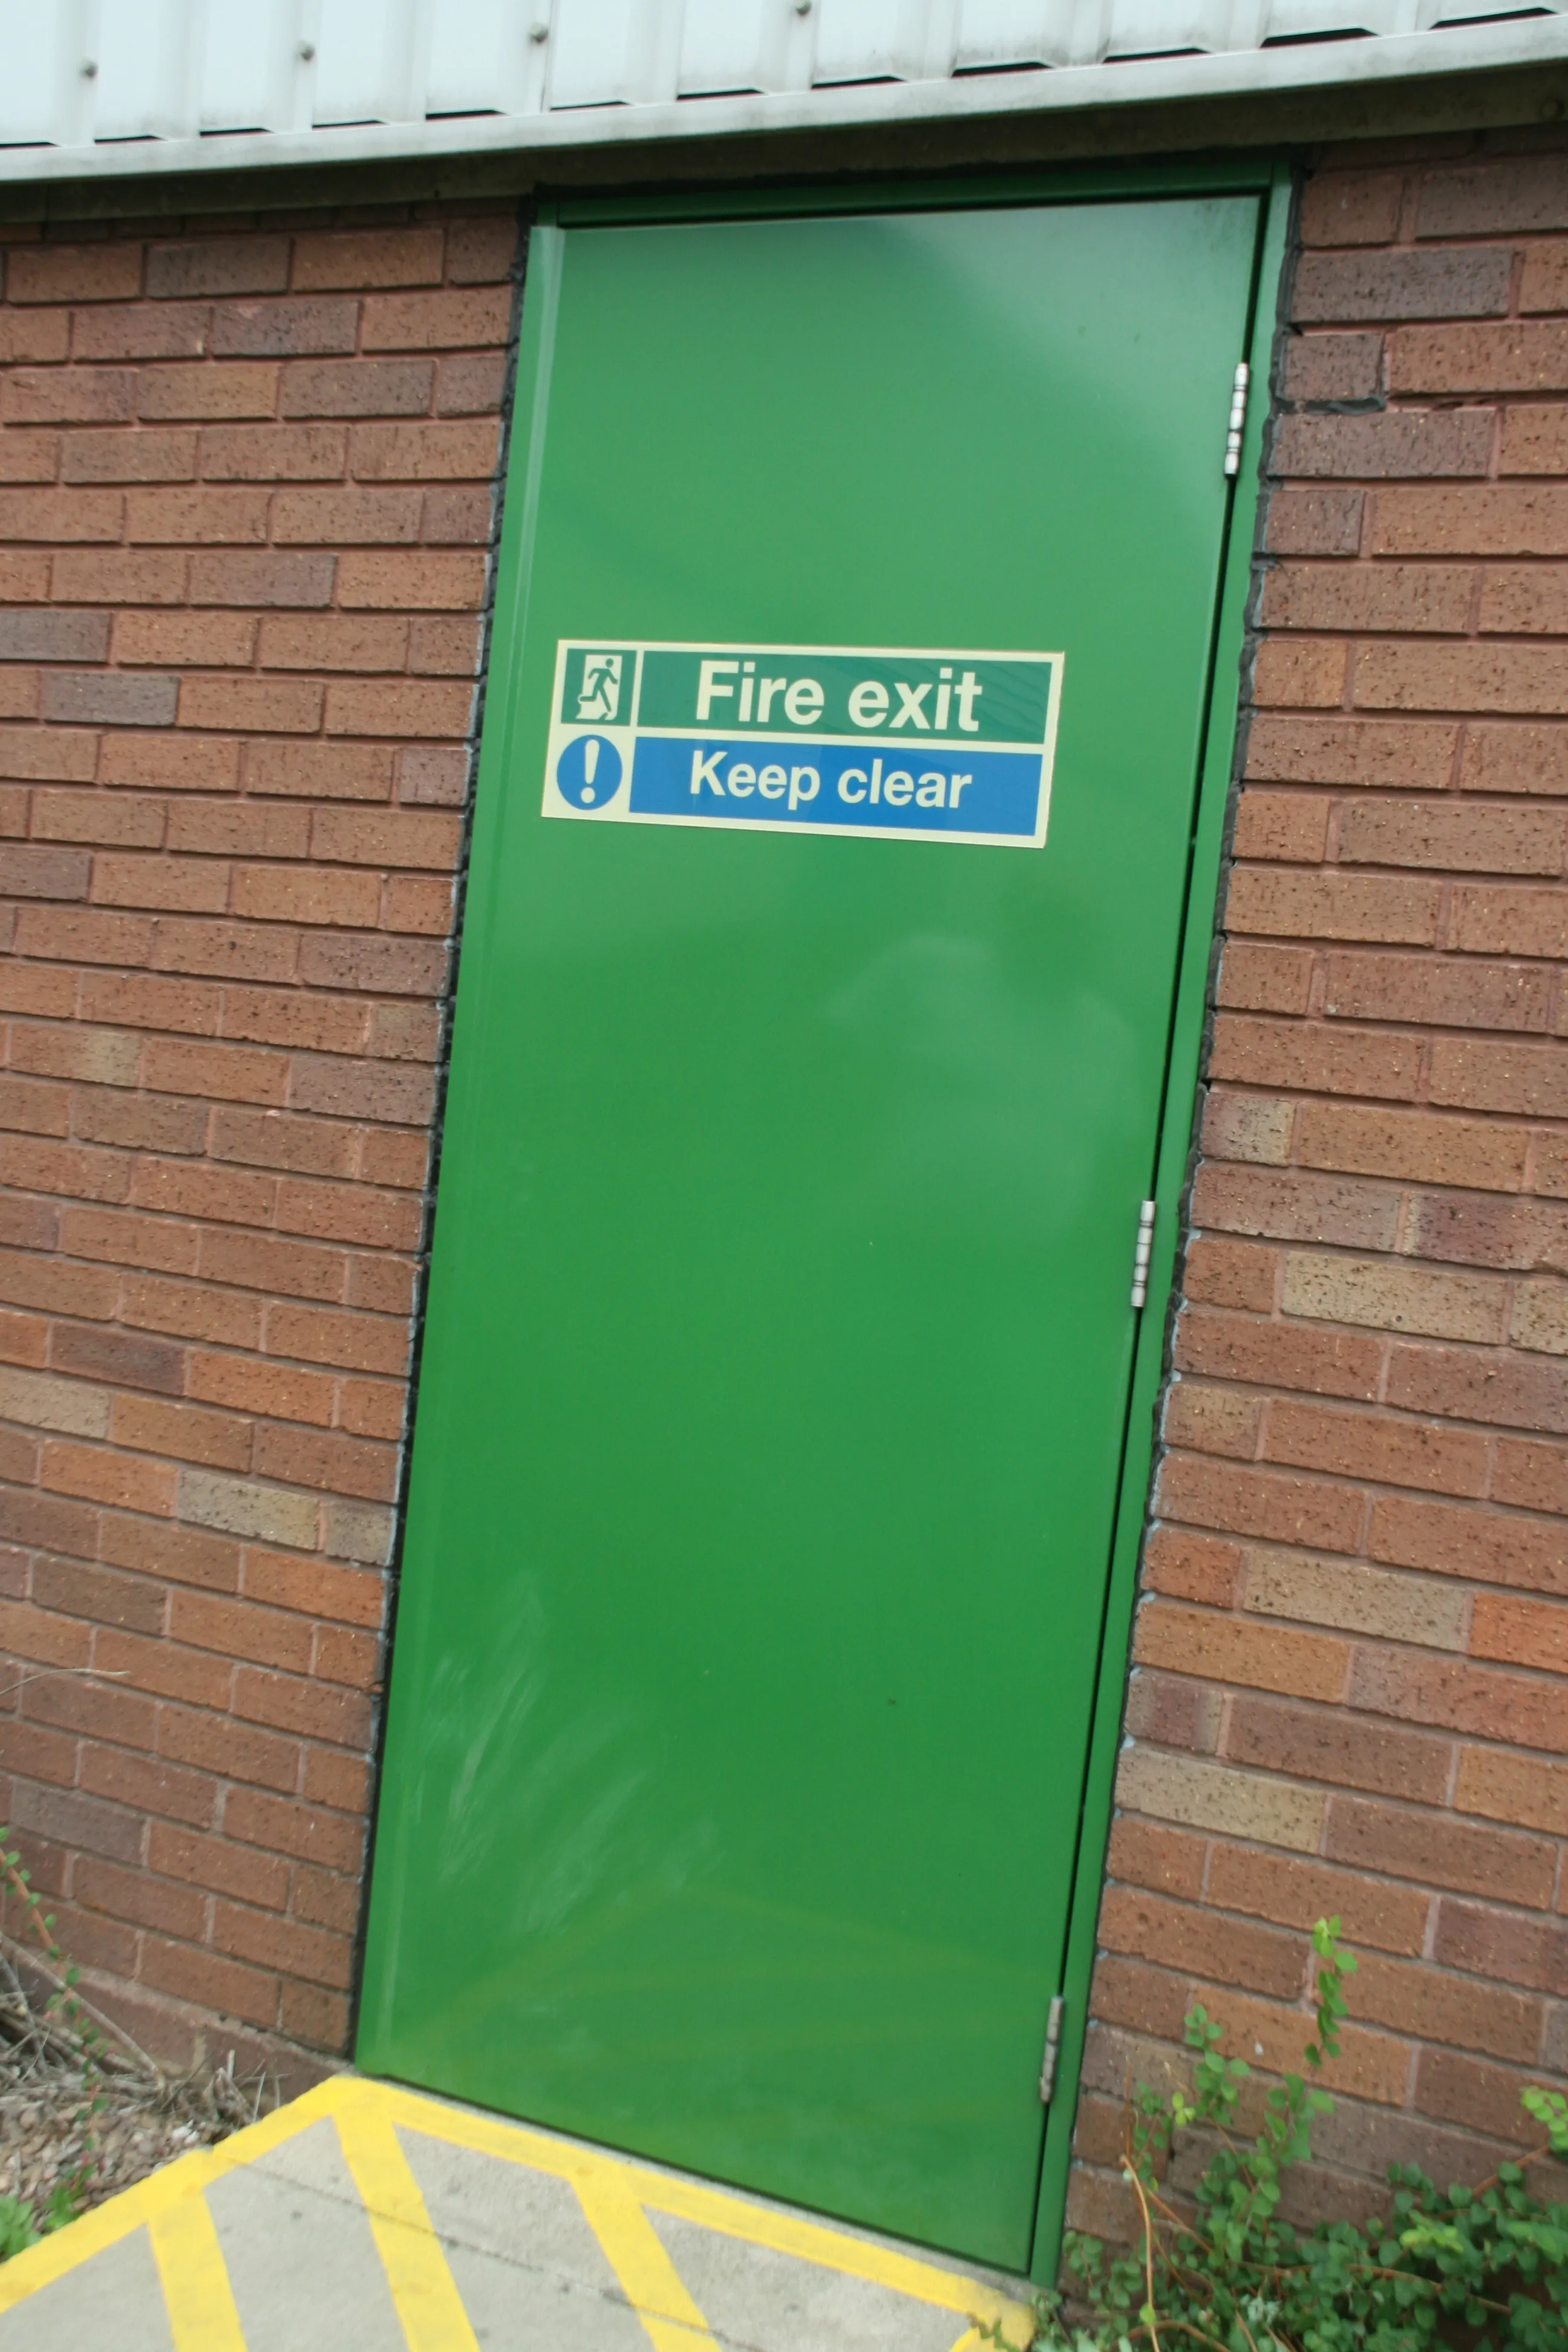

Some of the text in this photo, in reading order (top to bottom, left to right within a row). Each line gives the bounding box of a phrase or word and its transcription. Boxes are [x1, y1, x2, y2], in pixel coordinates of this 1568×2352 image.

[696, 659, 983, 732] Fire exit
[690, 750, 972, 811] Keep clear
